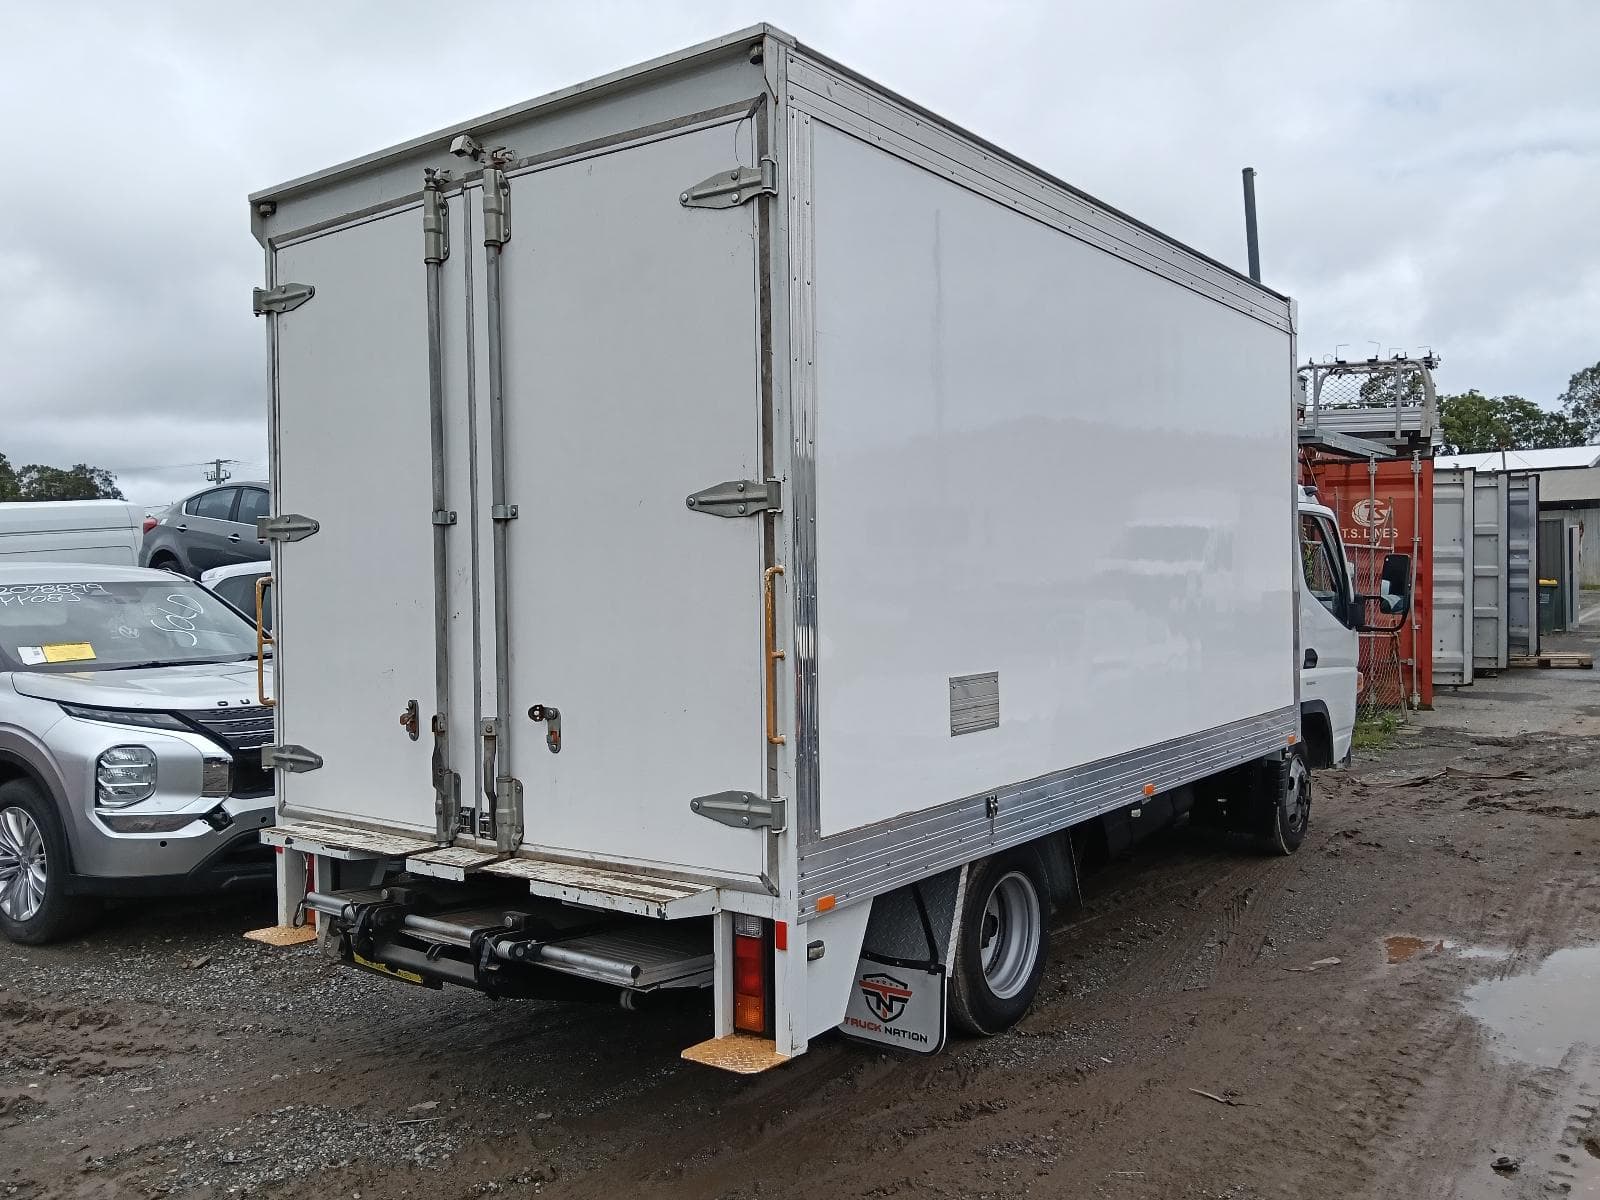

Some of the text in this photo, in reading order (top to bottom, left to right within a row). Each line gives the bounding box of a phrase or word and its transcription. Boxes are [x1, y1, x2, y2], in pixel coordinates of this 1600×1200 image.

[1341, 528, 1399, 539] T.S. LNES
[844, 1016, 928, 1044] TRUCK NATION
